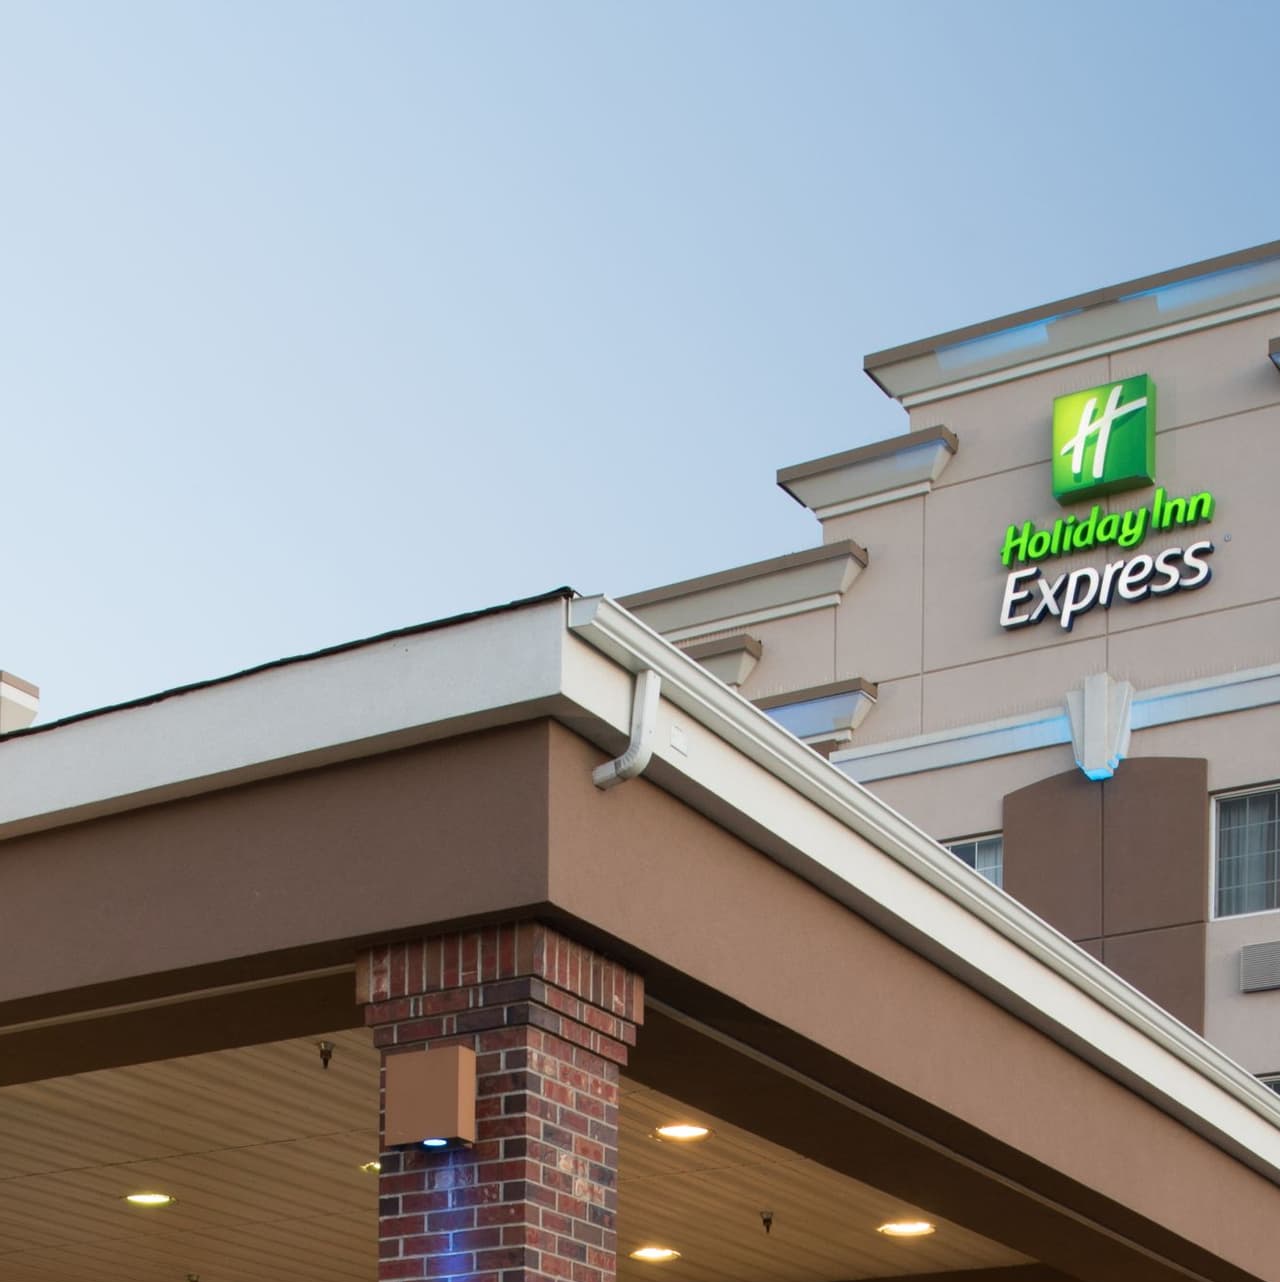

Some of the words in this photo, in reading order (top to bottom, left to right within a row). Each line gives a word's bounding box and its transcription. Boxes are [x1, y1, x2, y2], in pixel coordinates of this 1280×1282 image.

[1060, 385, 1147, 479] H
[1000, 504, 1150, 566] Holiday
[1152, 487, 1216, 530] Inn
[1000, 541, 1214, 632] Express
